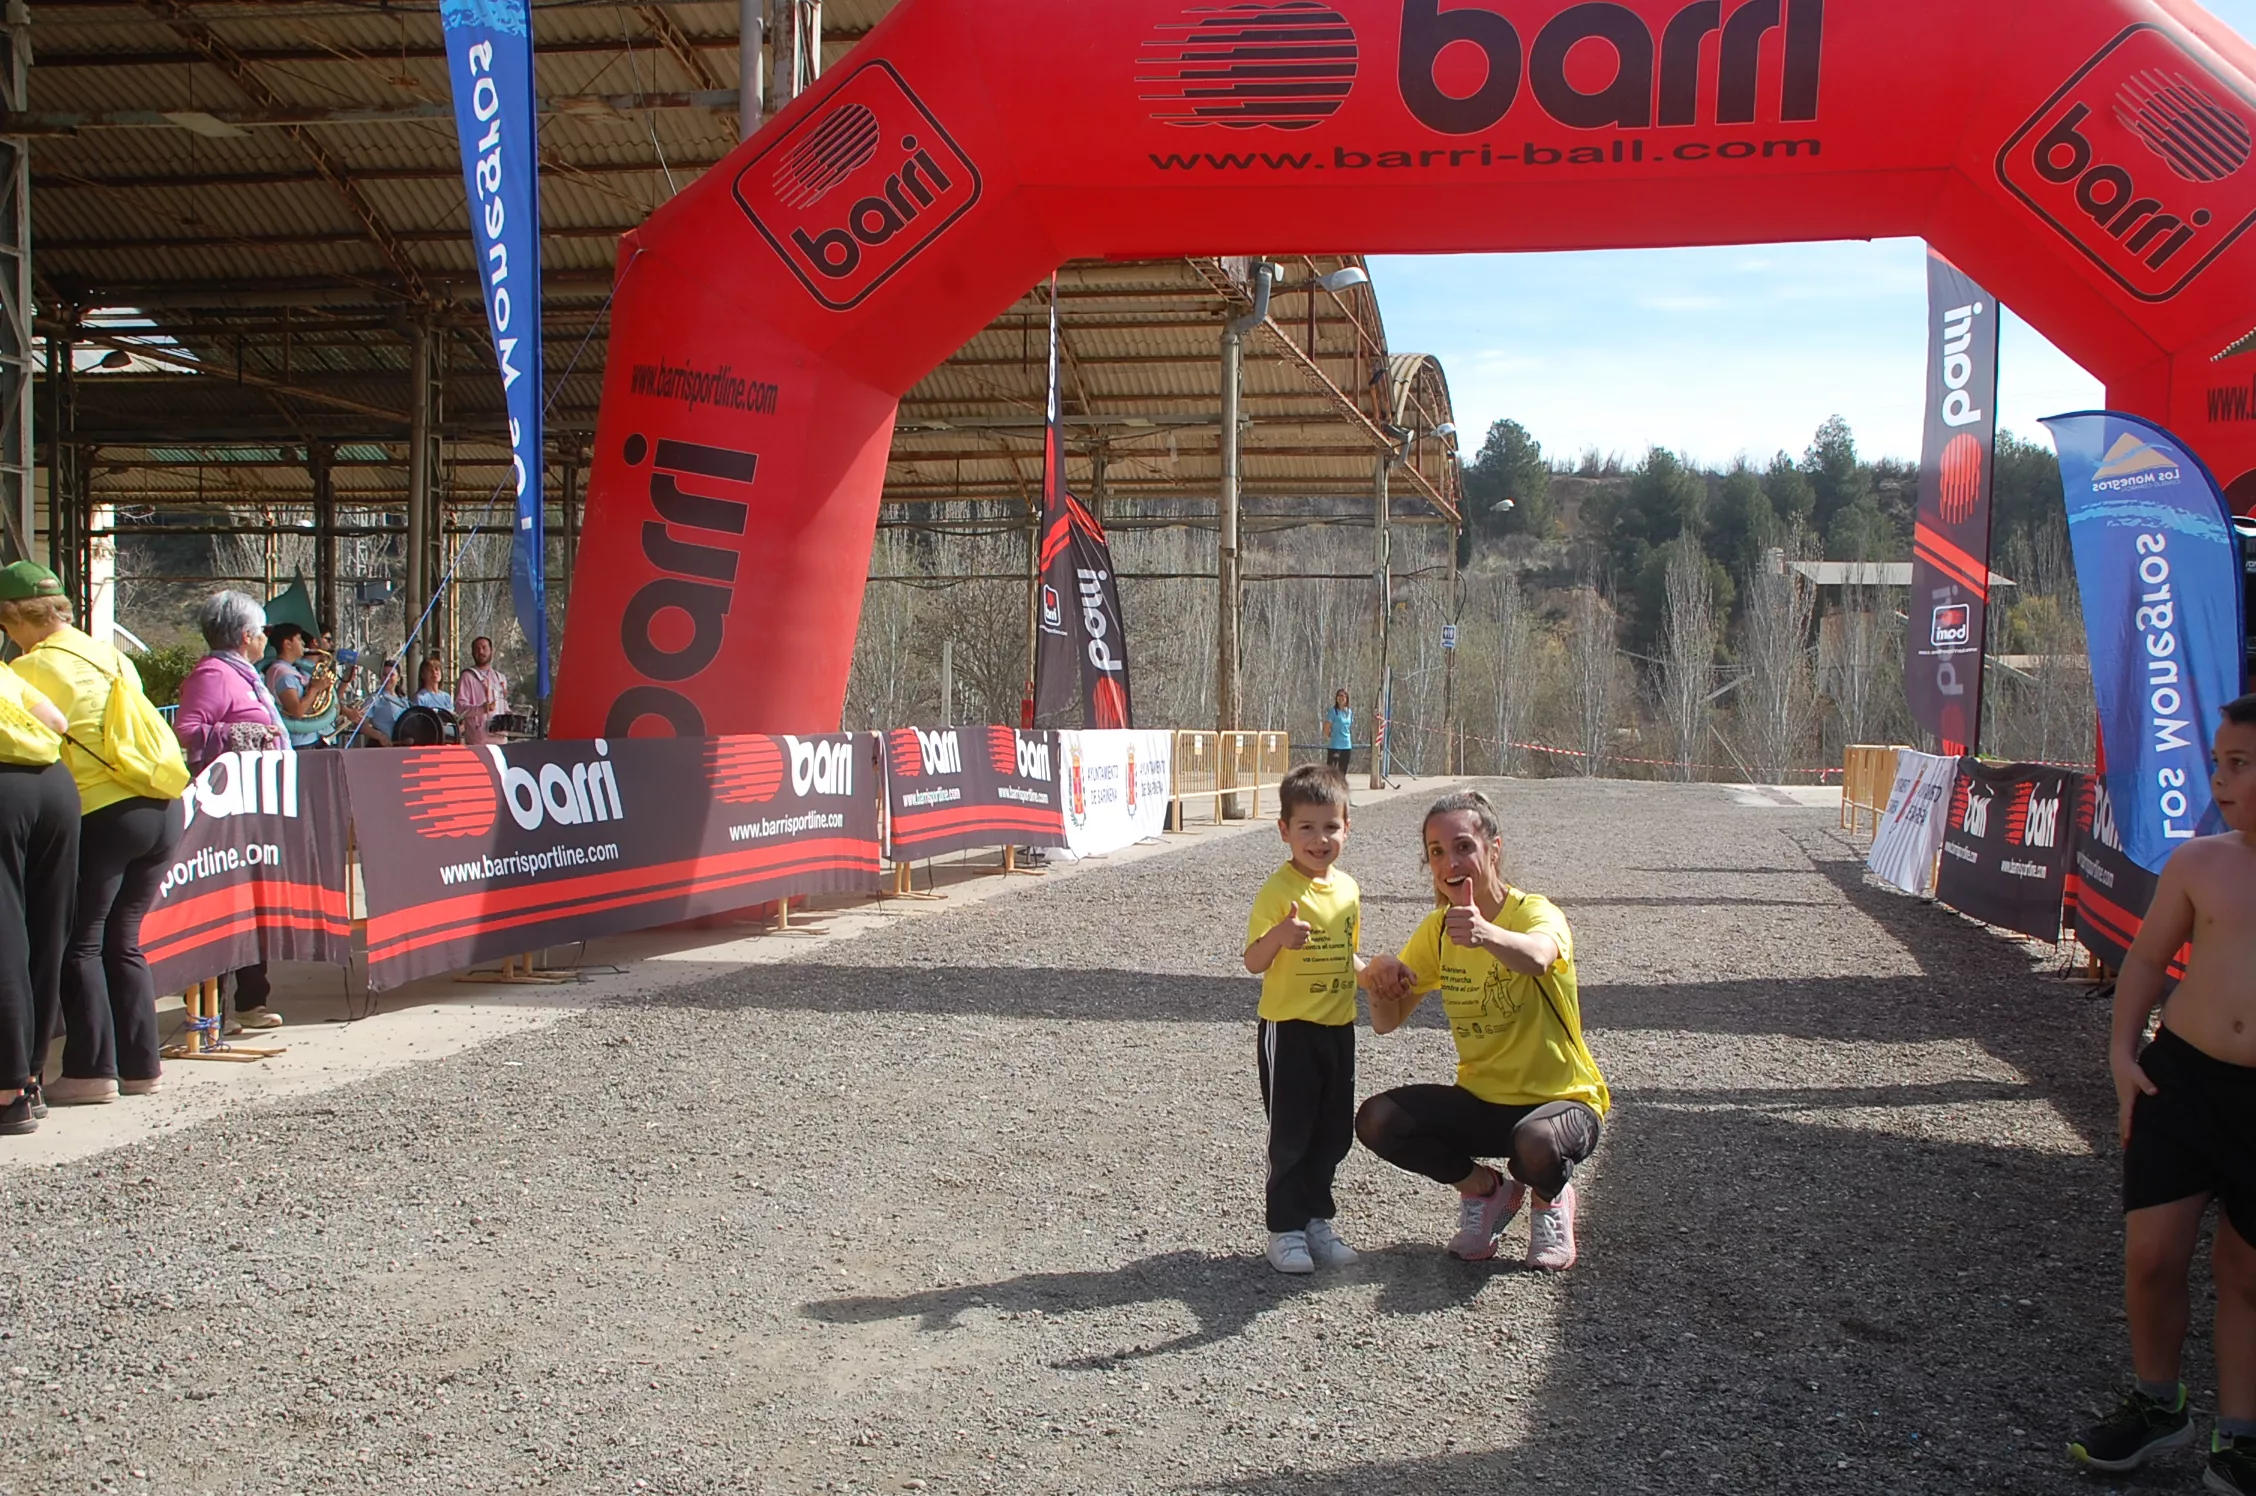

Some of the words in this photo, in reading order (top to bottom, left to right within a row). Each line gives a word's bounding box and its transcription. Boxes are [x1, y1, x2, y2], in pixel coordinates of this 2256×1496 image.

[1397, 0, 1824, 136] barri
[1148, 135, 1823, 171] www.barri-ball.com
[788, 134, 954, 279] barri
[2031, 101, 2212, 273] barri
[630, 355, 779, 416] www.barrisportline.com
[782, 732, 853, 797] barri
[909, 725, 962, 776] barri
[1014, 729, 1051, 782] barri
[486, 738, 624, 831] barri
[1963, 780, 1994, 839] barri
[2025, 779, 2062, 847] barri
[2092, 776, 2123, 852] bar
[729, 810, 844, 841] www.barrisportline.com
[440, 843, 619, 885] www.barrisportline.com
